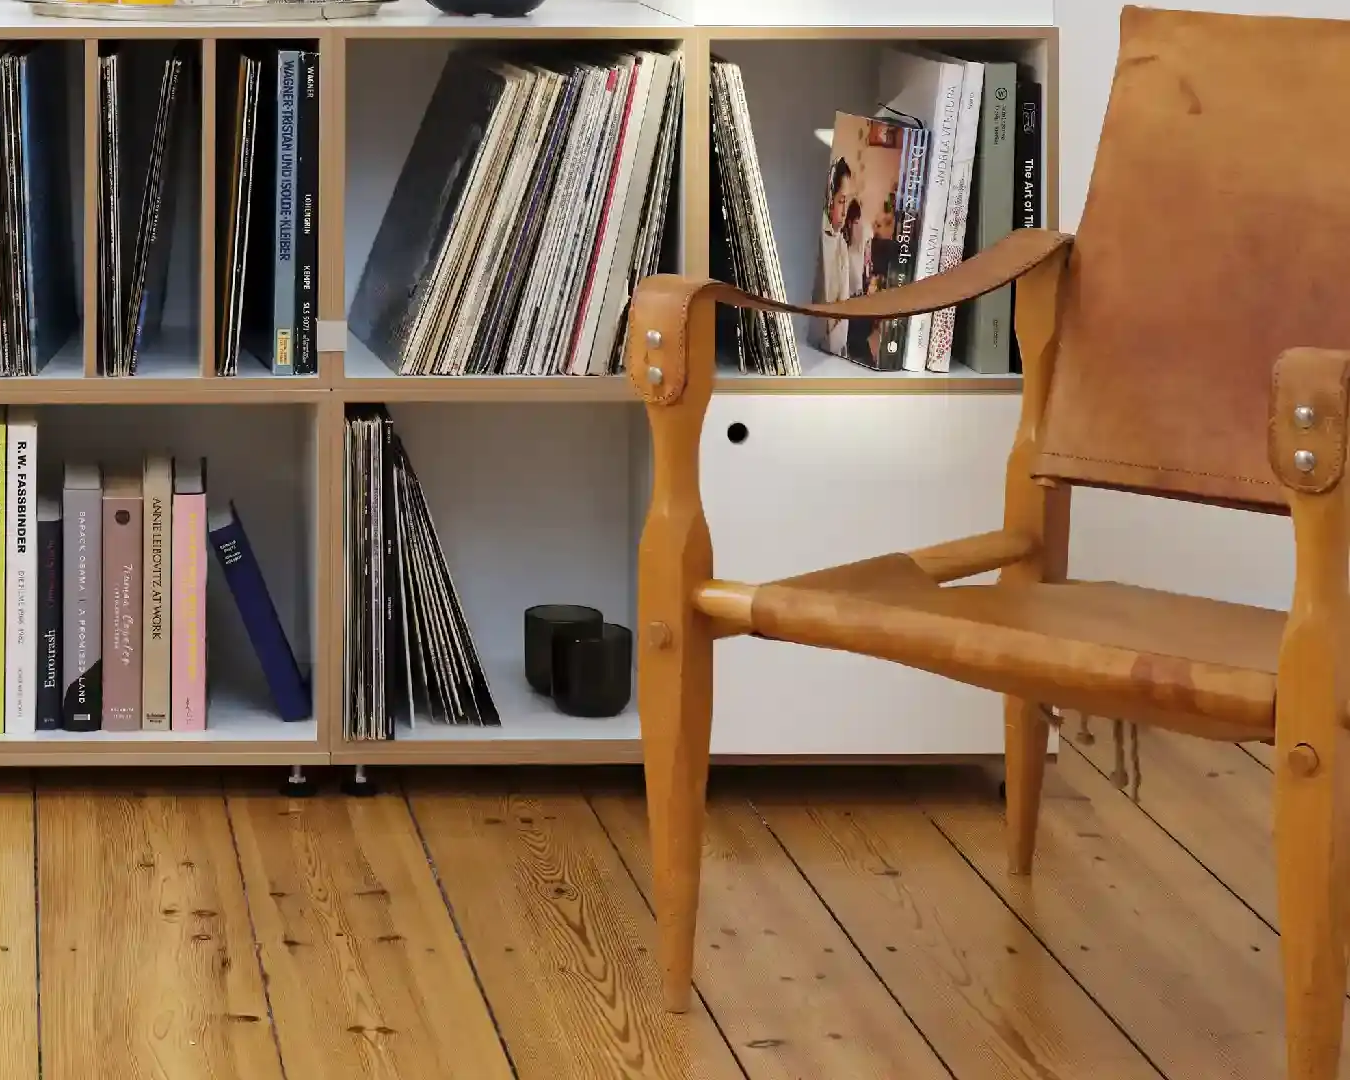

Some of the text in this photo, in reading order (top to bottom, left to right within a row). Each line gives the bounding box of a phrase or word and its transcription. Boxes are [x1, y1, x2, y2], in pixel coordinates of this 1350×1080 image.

[307, 66, 315, 98] WAGNER
[1024, 159, 1034, 179] The
[1024, 181, 1034, 202] Art
[1024, 202, 1034, 214] of
[303, 193, 312, 235] LOHENGRIN
[897, 211, 916, 264] Angels
[303, 265, 311, 290] KEMPE
[302, 302, 310, 314] SLS
[17, 441, 27, 553] R.W. FASSBINDER
[78, 511, 86, 552] BARACK
[78, 556, 86, 592] OBAMA
[152, 498, 162, 640] ANNIE LEIBOVITZ AT WORK
[44, 629, 56, 689] Eurotrash
[78, 620, 86, 672] PROMISED
[78, 677, 86, 704] LAND
